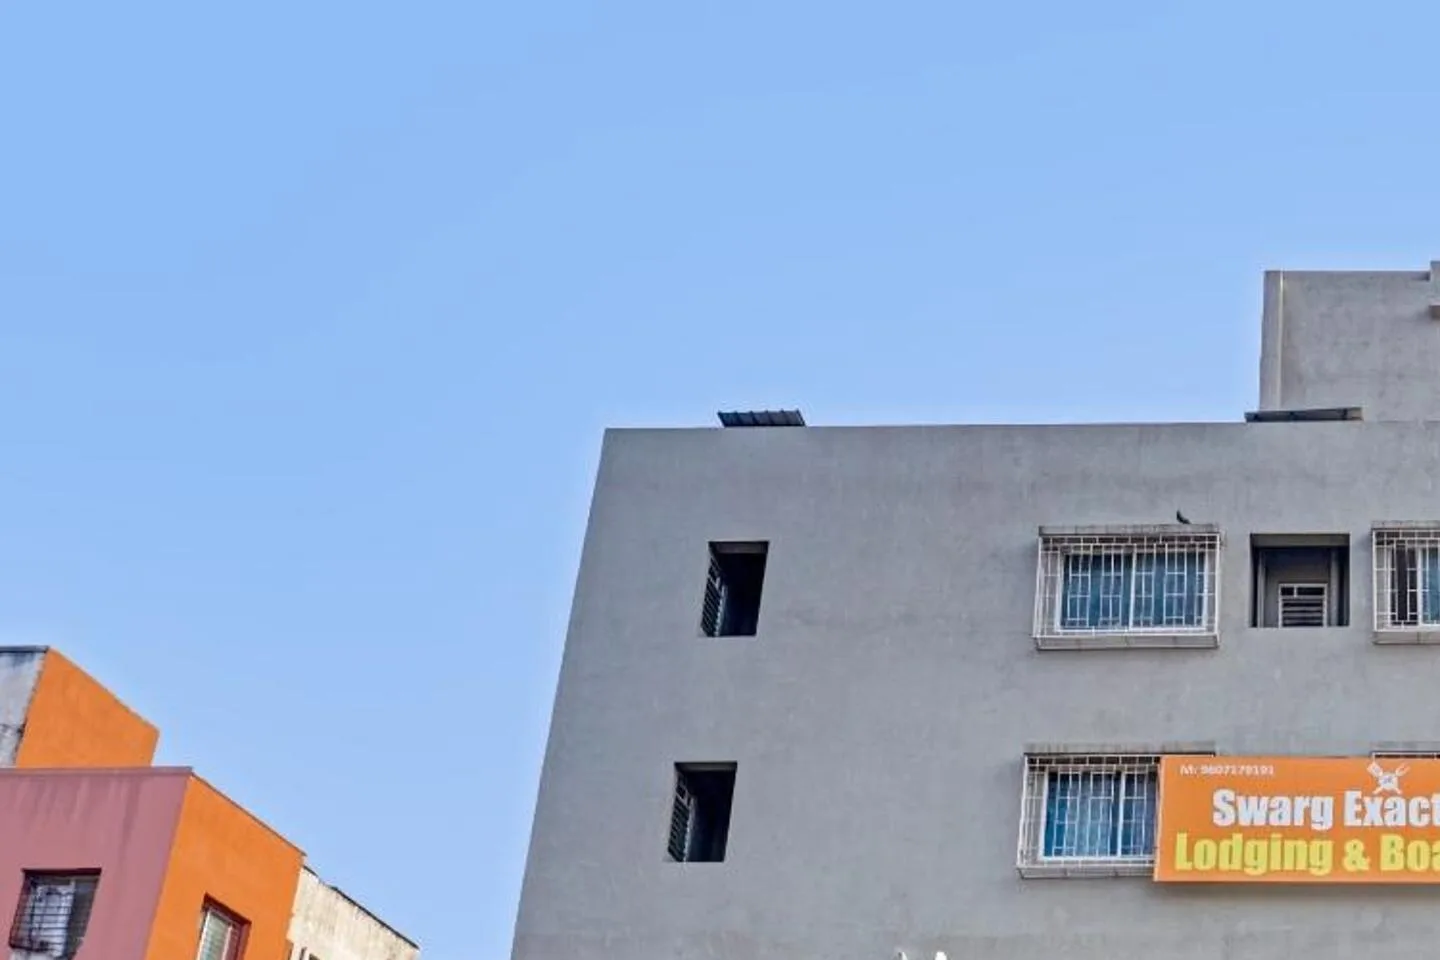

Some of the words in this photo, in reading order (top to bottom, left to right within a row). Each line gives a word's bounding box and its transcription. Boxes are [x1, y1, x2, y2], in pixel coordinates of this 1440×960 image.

[1212, 788, 1333, 830] Swarg
[1175, 832, 1333, 875] Lodging
[1342, 838, 1370, 871] &
